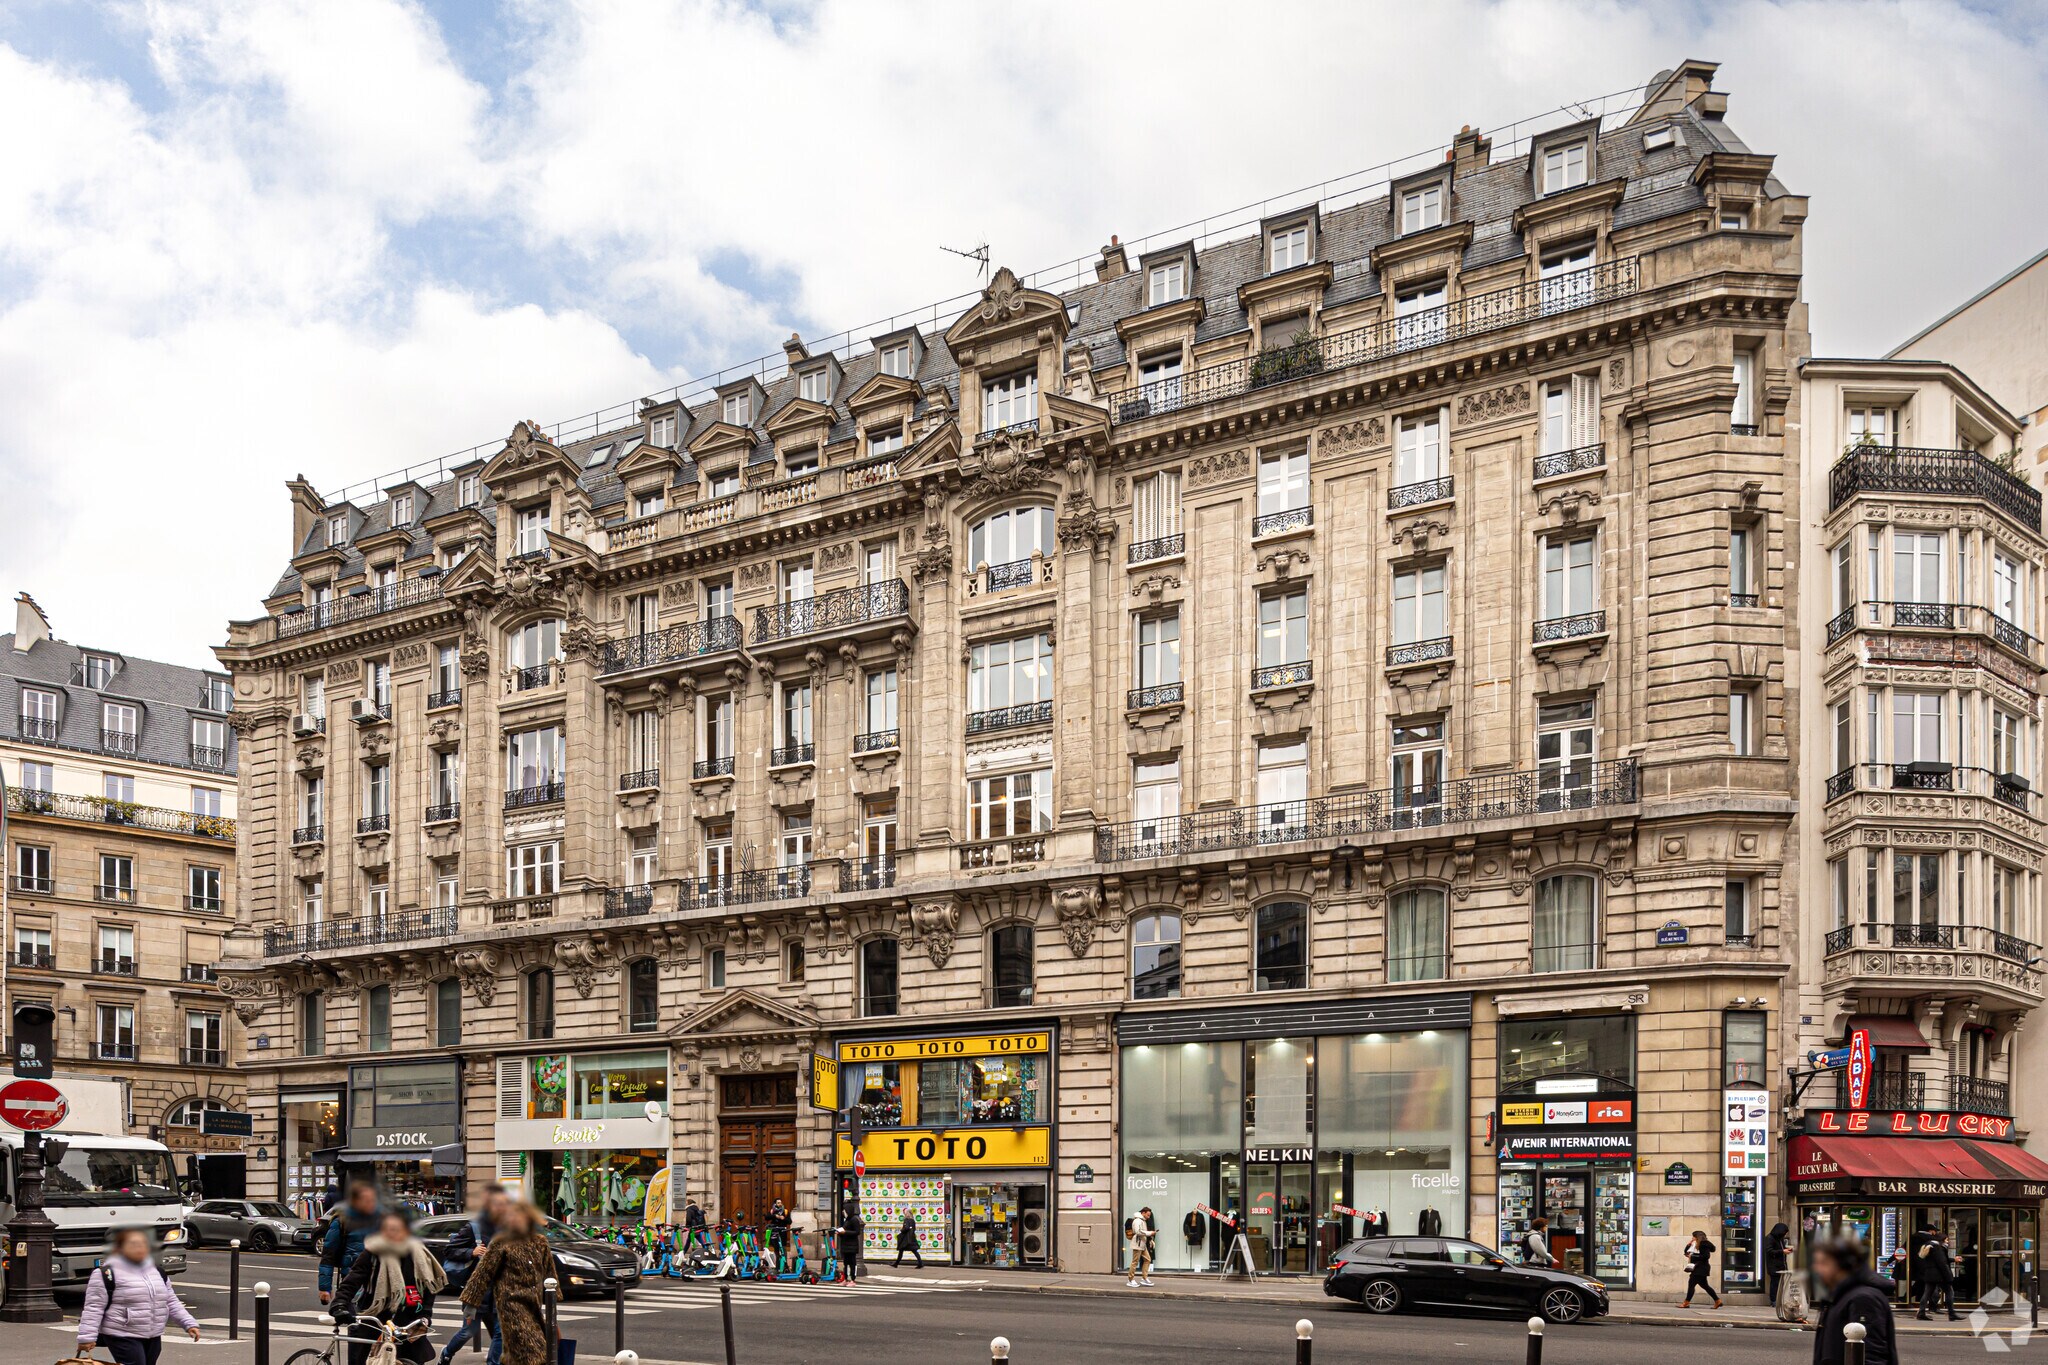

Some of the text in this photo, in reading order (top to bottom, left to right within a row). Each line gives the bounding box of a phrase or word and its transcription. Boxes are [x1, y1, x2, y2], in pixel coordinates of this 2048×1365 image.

[1627, 993, 1645, 1004] SR
[850, 1037, 1038, 1058] TOTO TOTO TOTO
[815, 1058, 836, 1075] TOTO
[1852, 1037, 1862, 1099] TABAC
[607, 1073, 627, 1083] Votre
[1556, 1109, 1584, 1118] MoneyGram
[1597, 1106, 1624, 1118] ria
[1820, 1112, 2011, 1137] LE LUCKY
[376, 1132, 427, 1146] D.STOCK
[552, 1123, 600, 1144] Ensuite
[893, 1136, 987, 1161] TOTO
[1511, 1136, 1632, 1149] AVENIR INTERNATIONAL
[1246, 1148, 1313, 1162] NELKIN
[1812, 1152, 1822, 1161] LE
[1797, 1162, 1838, 1176] LUCKY BAR
[1126, 1175, 1168, 1190] ficelle
[1410, 1173, 1460, 1188] ficelle
[1799, 1181, 1836, 1193] BRASSERIE
[1878, 1181, 1996, 1195] BAR BRASSERIE
[2023, 1184, 2046, 1196] TABAC
